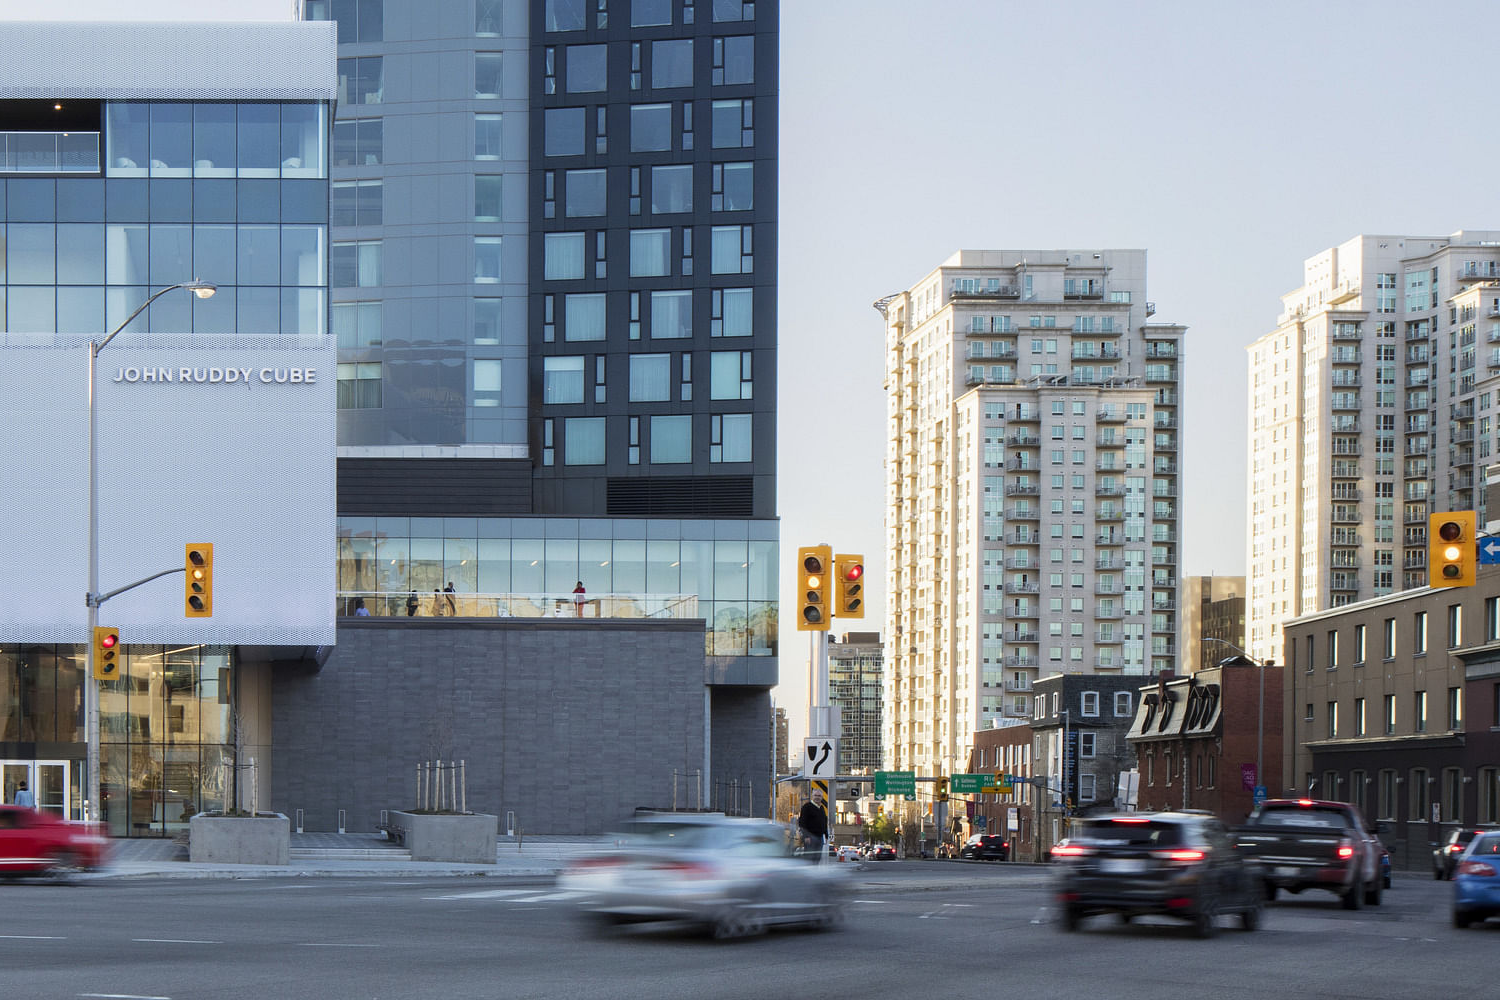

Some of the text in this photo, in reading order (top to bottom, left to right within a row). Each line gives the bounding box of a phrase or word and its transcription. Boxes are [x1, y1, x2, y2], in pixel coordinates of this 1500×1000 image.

[113, 367, 317, 384] JOHN RUDDY CUBE
